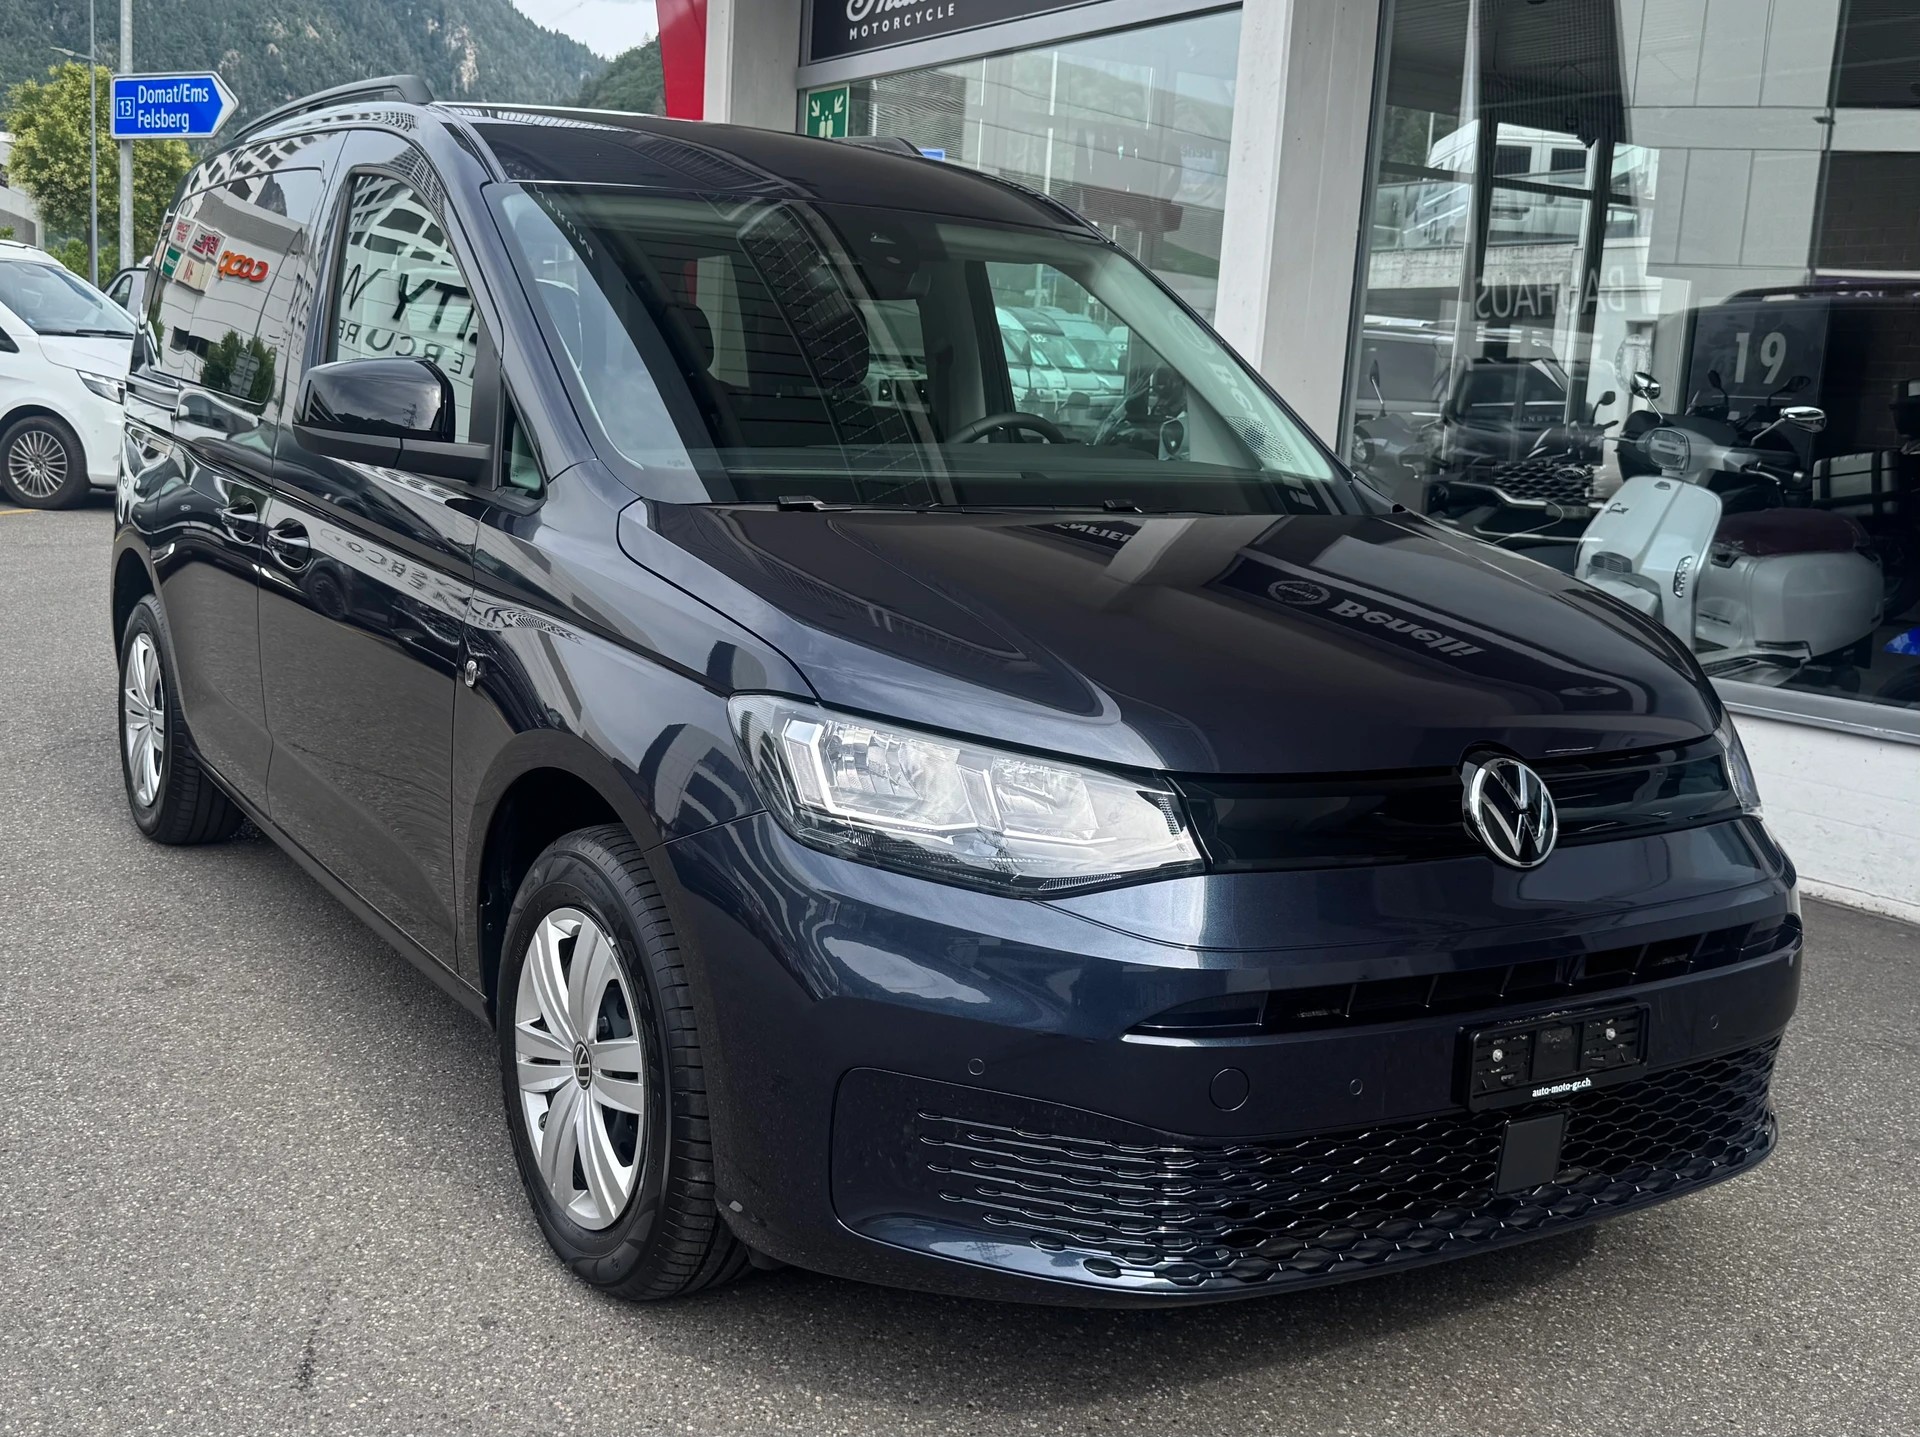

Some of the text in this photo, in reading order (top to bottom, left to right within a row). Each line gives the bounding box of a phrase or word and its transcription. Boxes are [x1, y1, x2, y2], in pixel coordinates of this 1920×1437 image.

[849, 3, 955, 41] MOTORCYCLE
[137, 83, 209, 104] Domat/Ems
[120, 100, 132, 116] 13
[137, 107, 190, 133] Felsberg
[1734, 332, 1787, 384] 19
[1532, 1077, 1592, 1098] auto-moto-gr.ch
